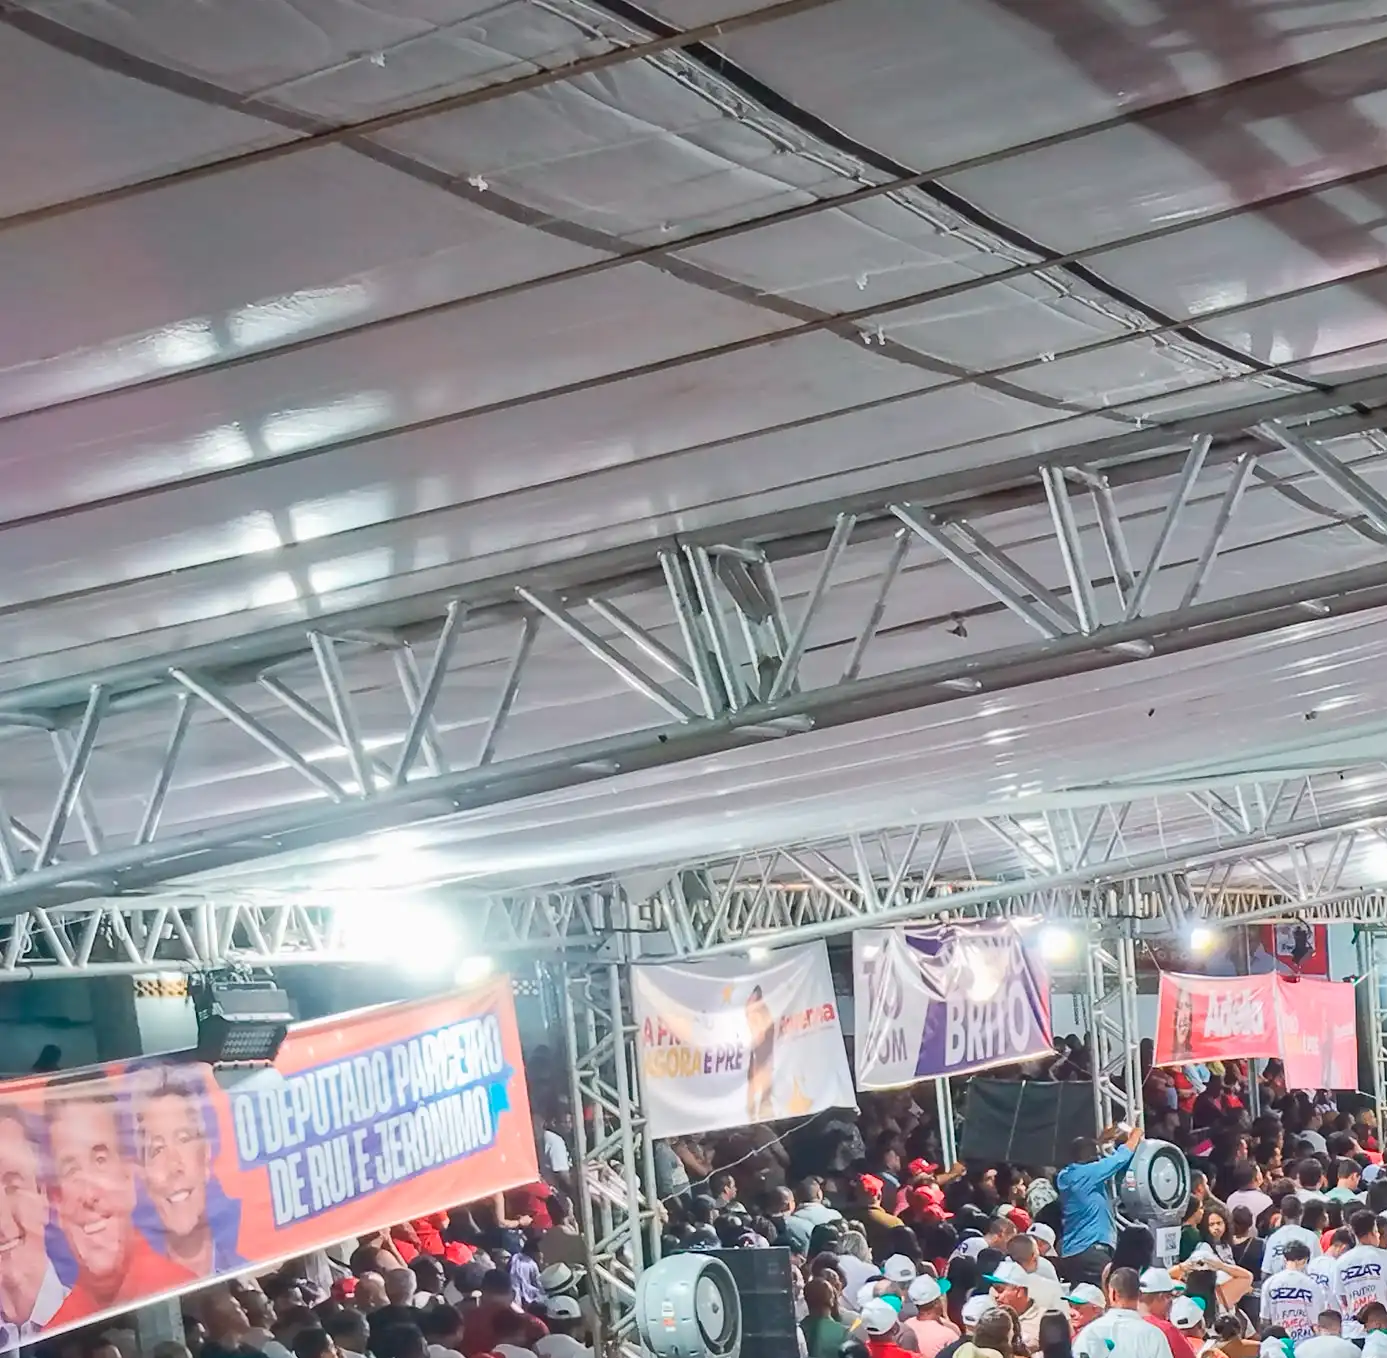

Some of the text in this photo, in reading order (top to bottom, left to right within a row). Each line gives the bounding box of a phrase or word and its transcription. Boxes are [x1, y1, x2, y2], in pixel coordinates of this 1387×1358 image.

[235, 1013, 501, 1162] O DEPUTADO PARCEIRO
[268, 1085, 494, 1226] DE RUI E JERÔNIMO
